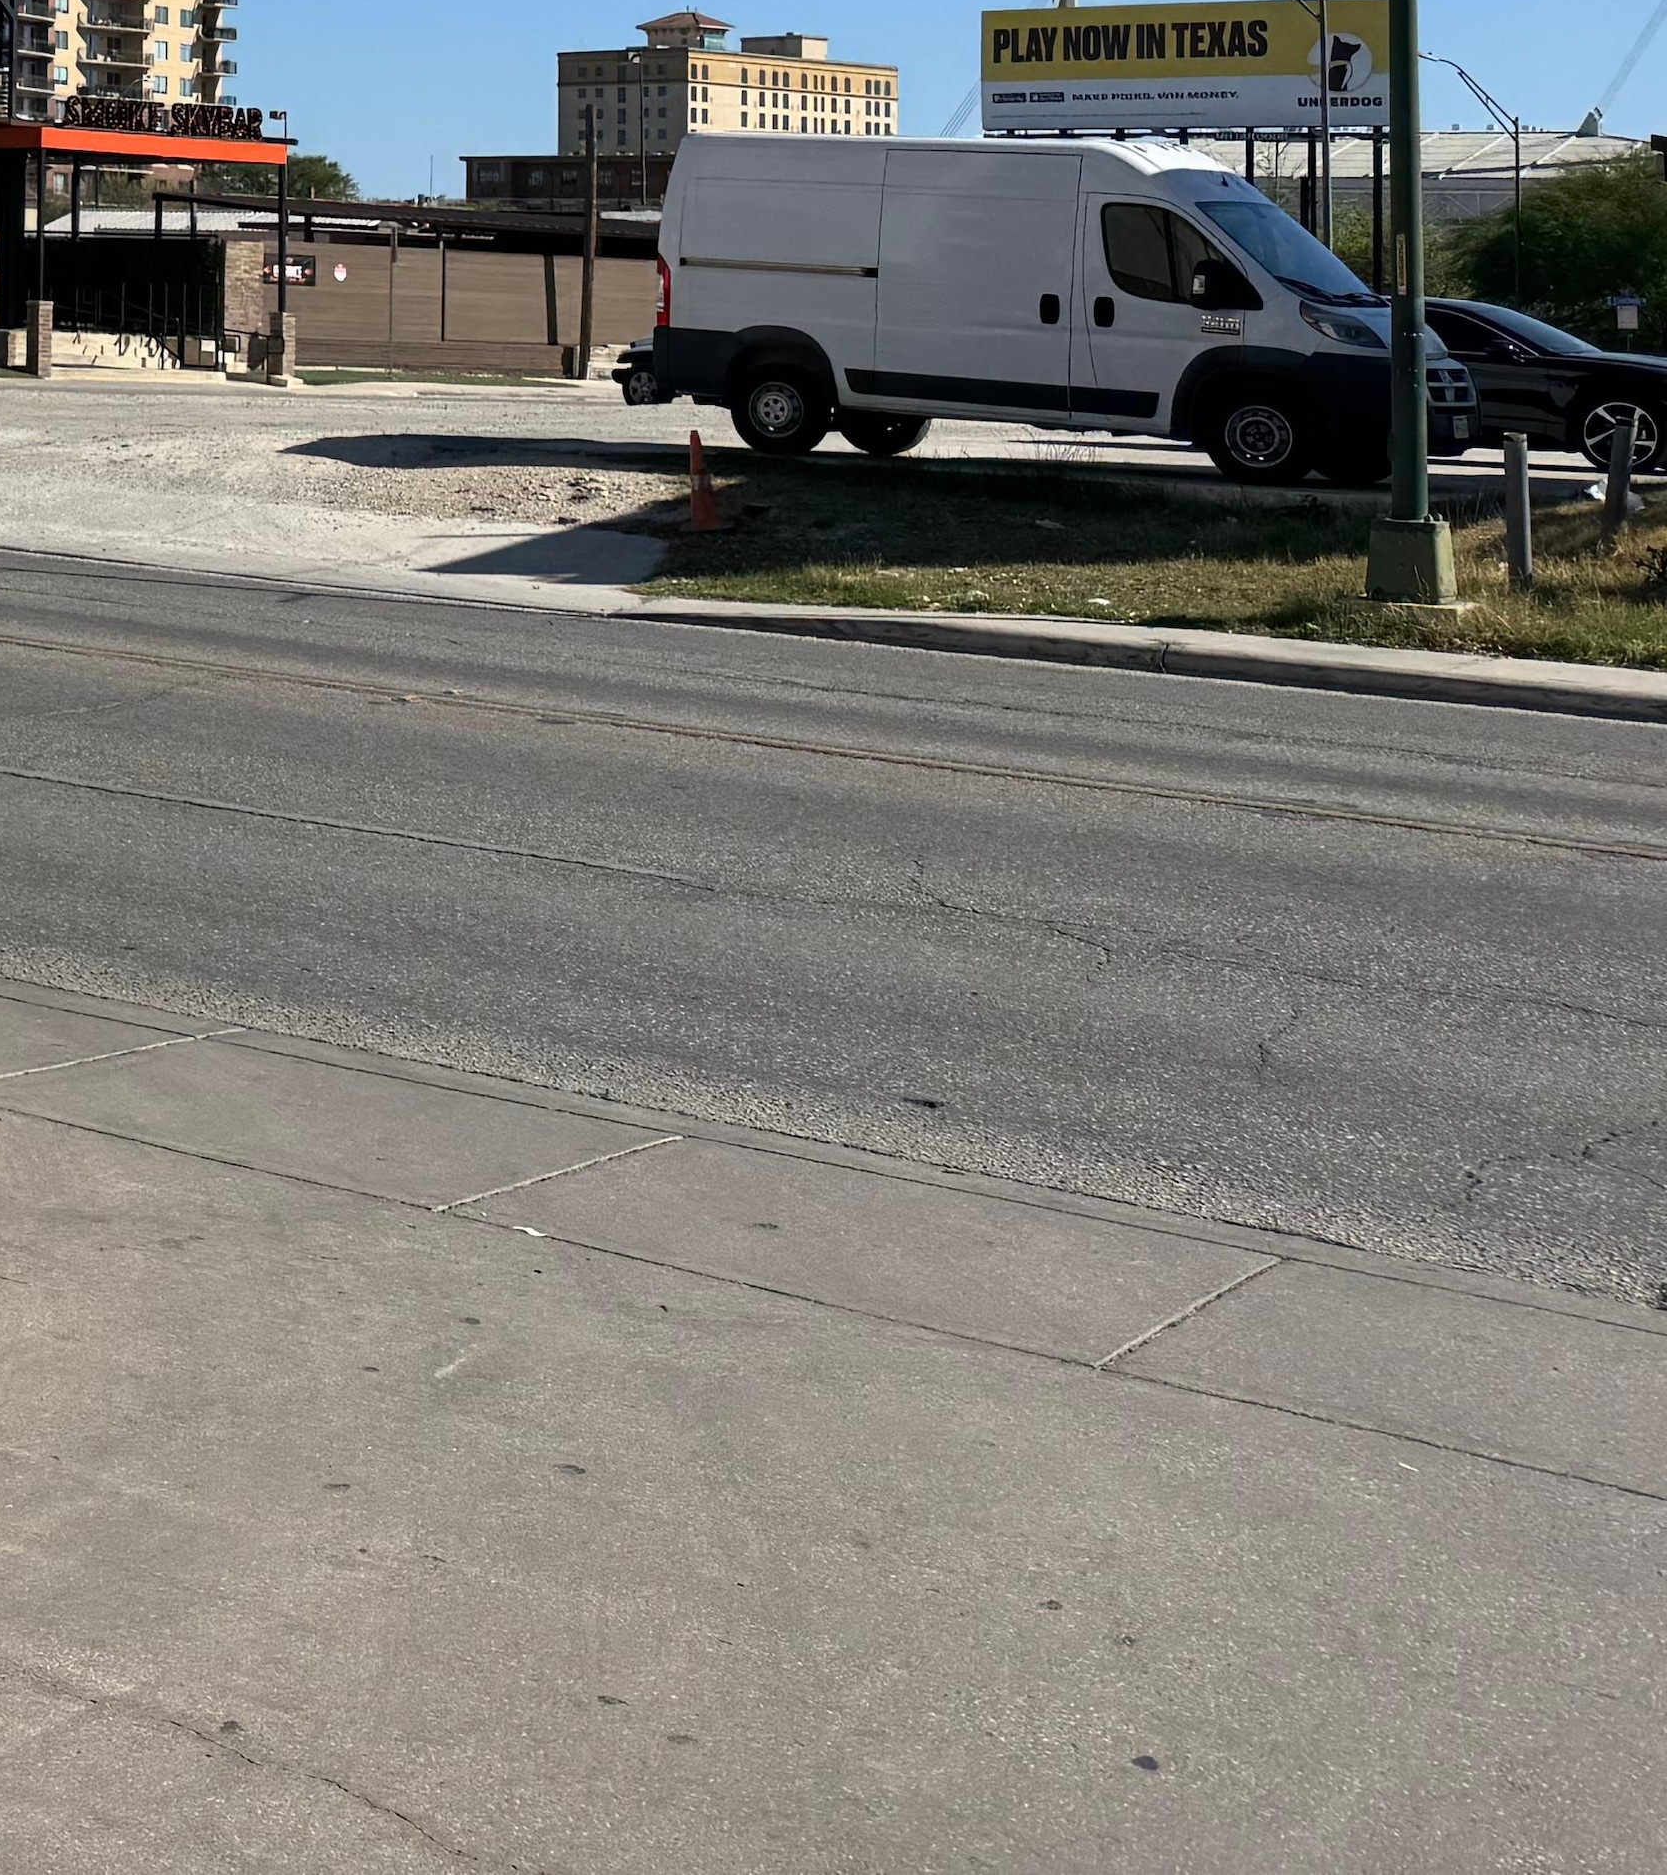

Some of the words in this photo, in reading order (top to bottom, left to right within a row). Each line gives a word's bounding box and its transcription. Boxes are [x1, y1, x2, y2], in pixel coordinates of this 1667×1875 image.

[992, 27, 1058, 64] PLAY
[1063, 24, 1131, 62] NOW
[1135, 23, 1166, 59] IN
[1171, 19, 1268, 59] TEXAS
[66, 94, 166, 132] SMOKE
[170, 102, 264, 141] SKYBAR
[1297, 96, 1383, 108] UNERDOG
